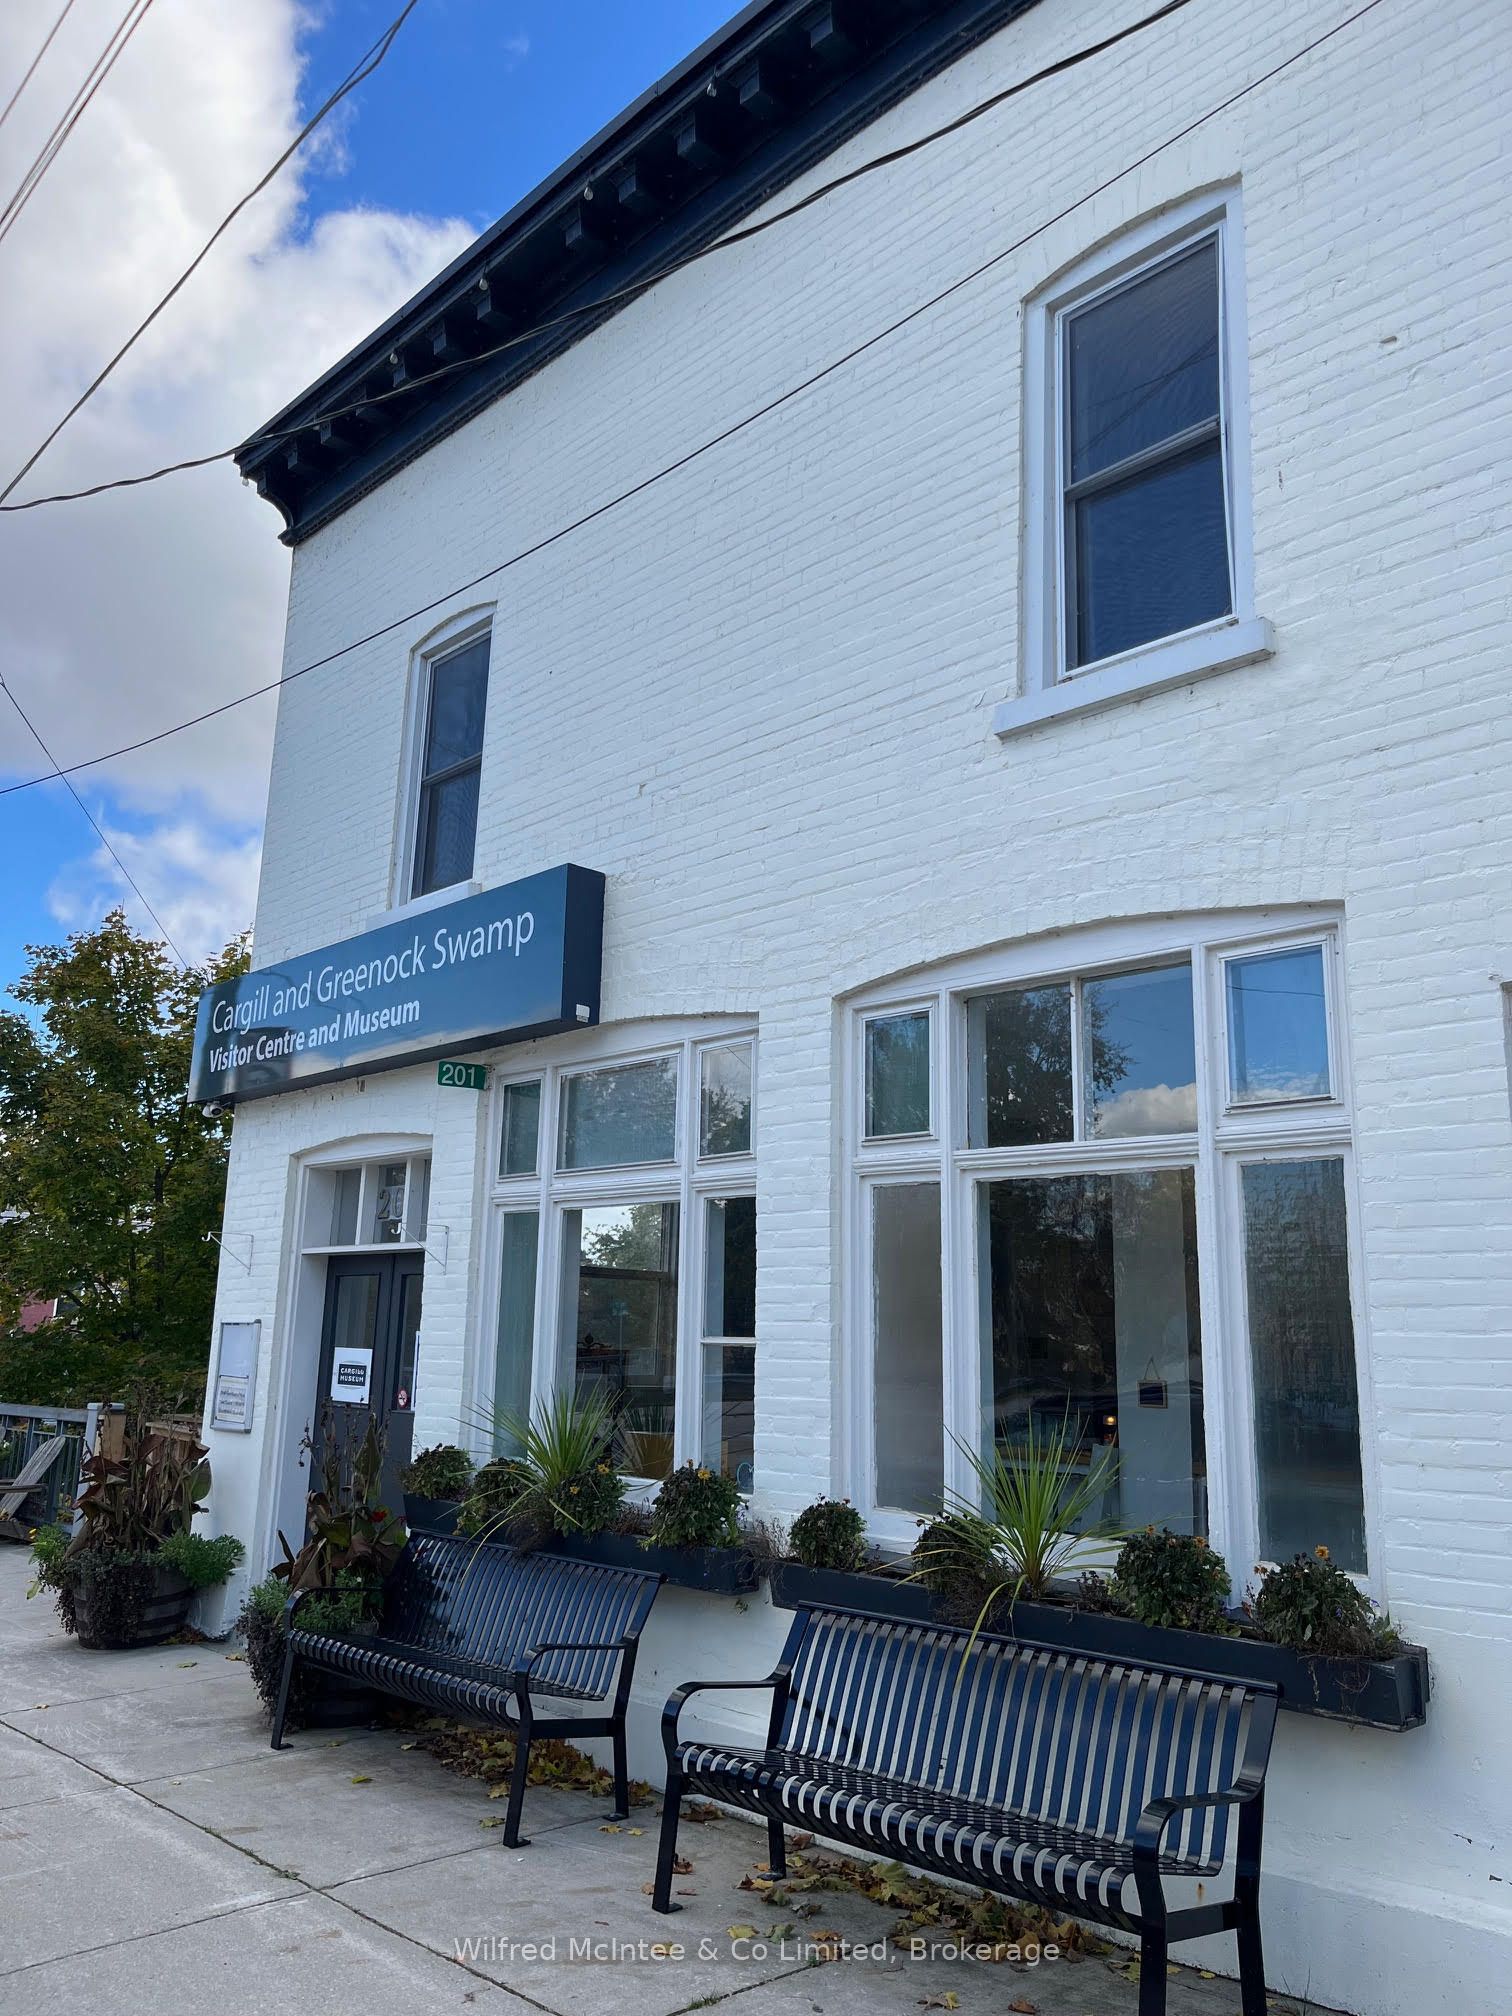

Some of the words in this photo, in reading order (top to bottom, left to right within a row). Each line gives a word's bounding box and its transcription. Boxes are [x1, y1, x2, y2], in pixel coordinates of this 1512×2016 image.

[212, 984, 270, 1036] Cargill
[272, 970, 313, 1017] and
[316, 935, 427, 1003] Greenock
[431, 911, 535, 970] Swamp
[209, 1043, 254, 1073] Visitor
[255, 1029, 305, 1061] Centre
[307, 1013, 341, 1048] and
[343, 1000, 420, 1039] Museum
[441, 1063, 476, 1087] 201
[339, 1375, 364, 1383] MUSEUM
